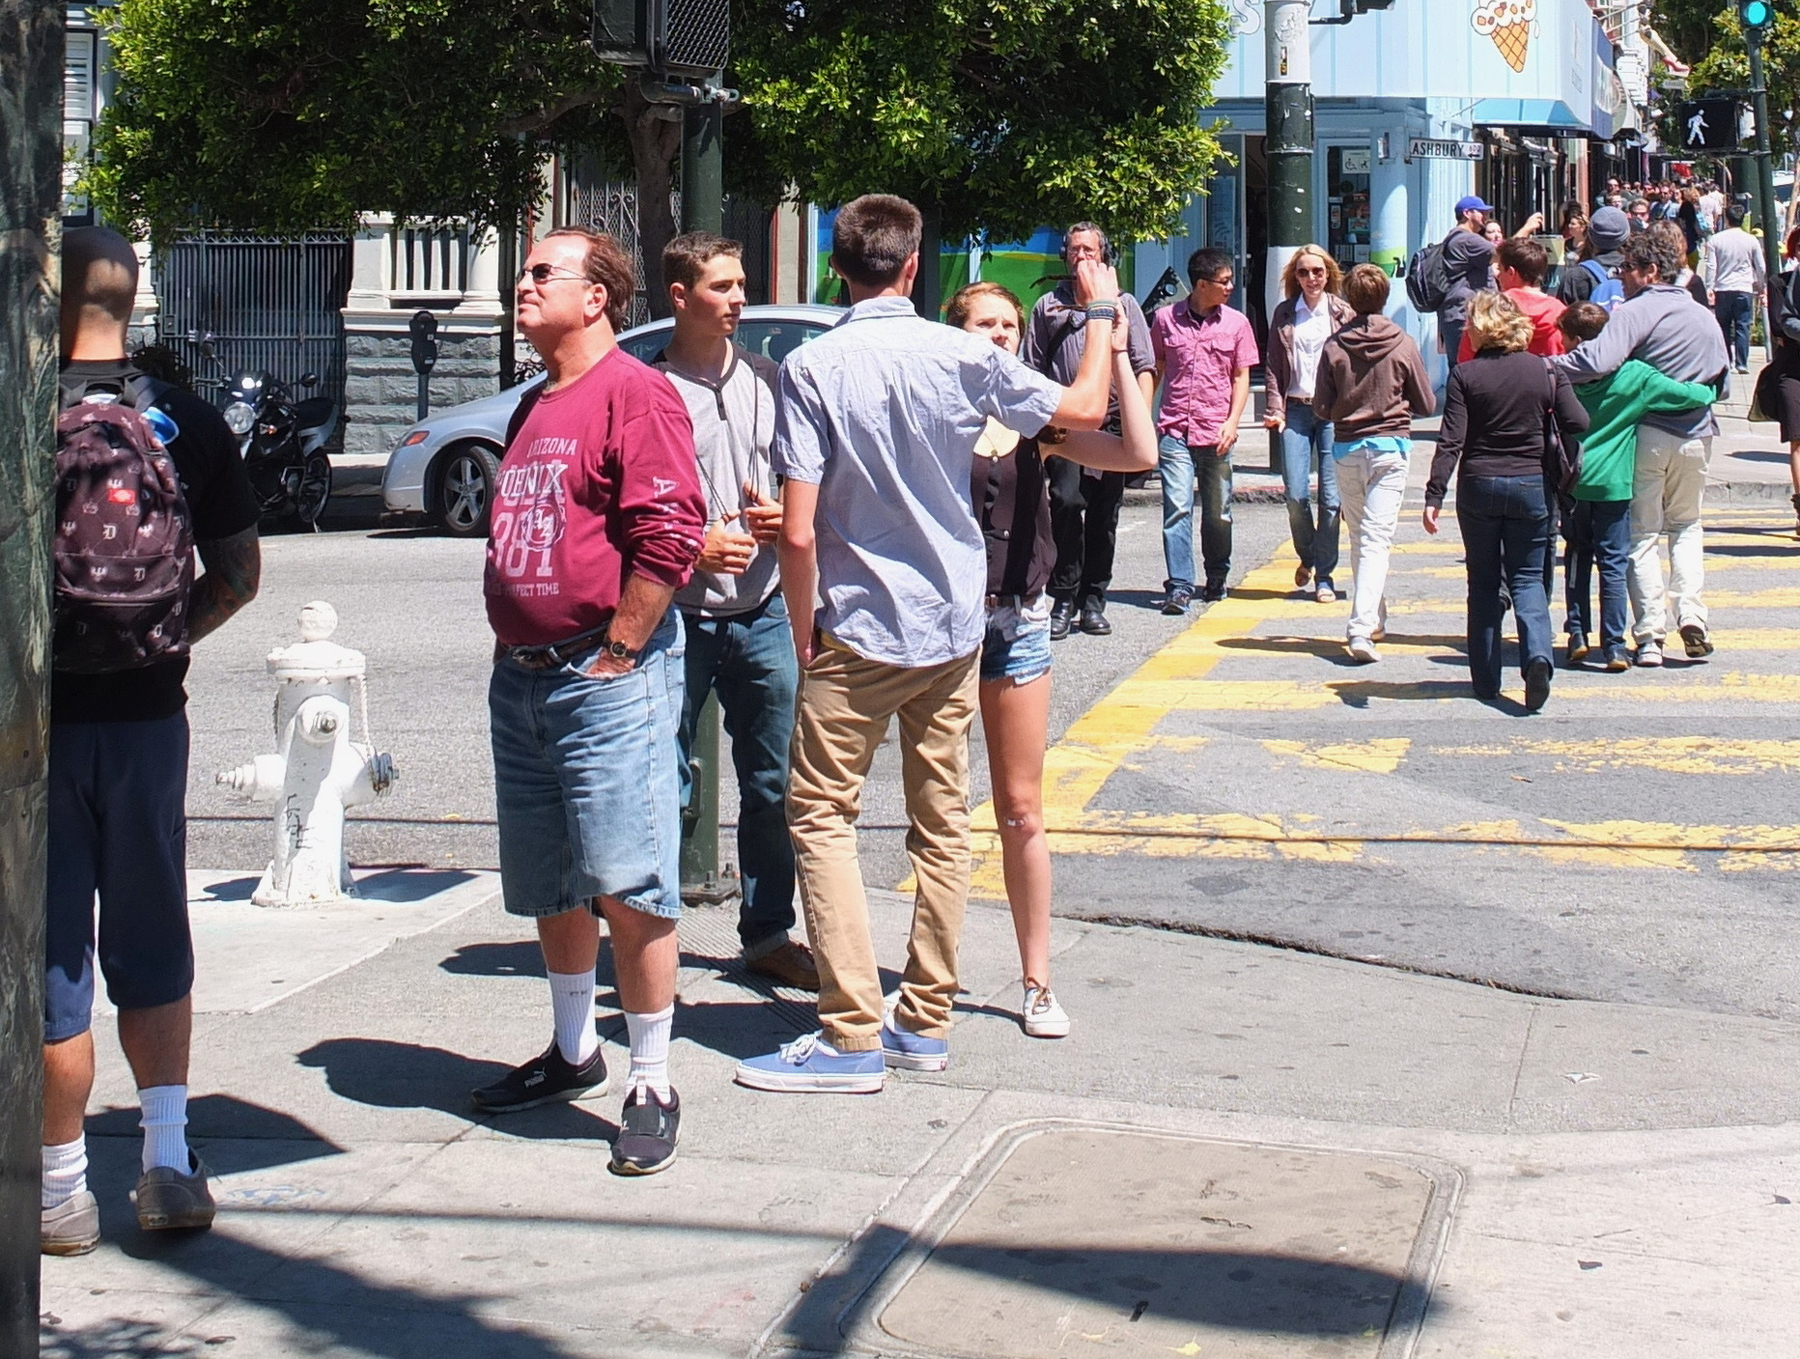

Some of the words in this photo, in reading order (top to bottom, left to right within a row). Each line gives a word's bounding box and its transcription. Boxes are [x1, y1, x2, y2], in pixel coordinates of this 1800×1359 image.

[1412, 142, 1464, 157] ASHBURY
[495, 463, 569, 498] OENIX
[536, 583, 560, 596] TIME
